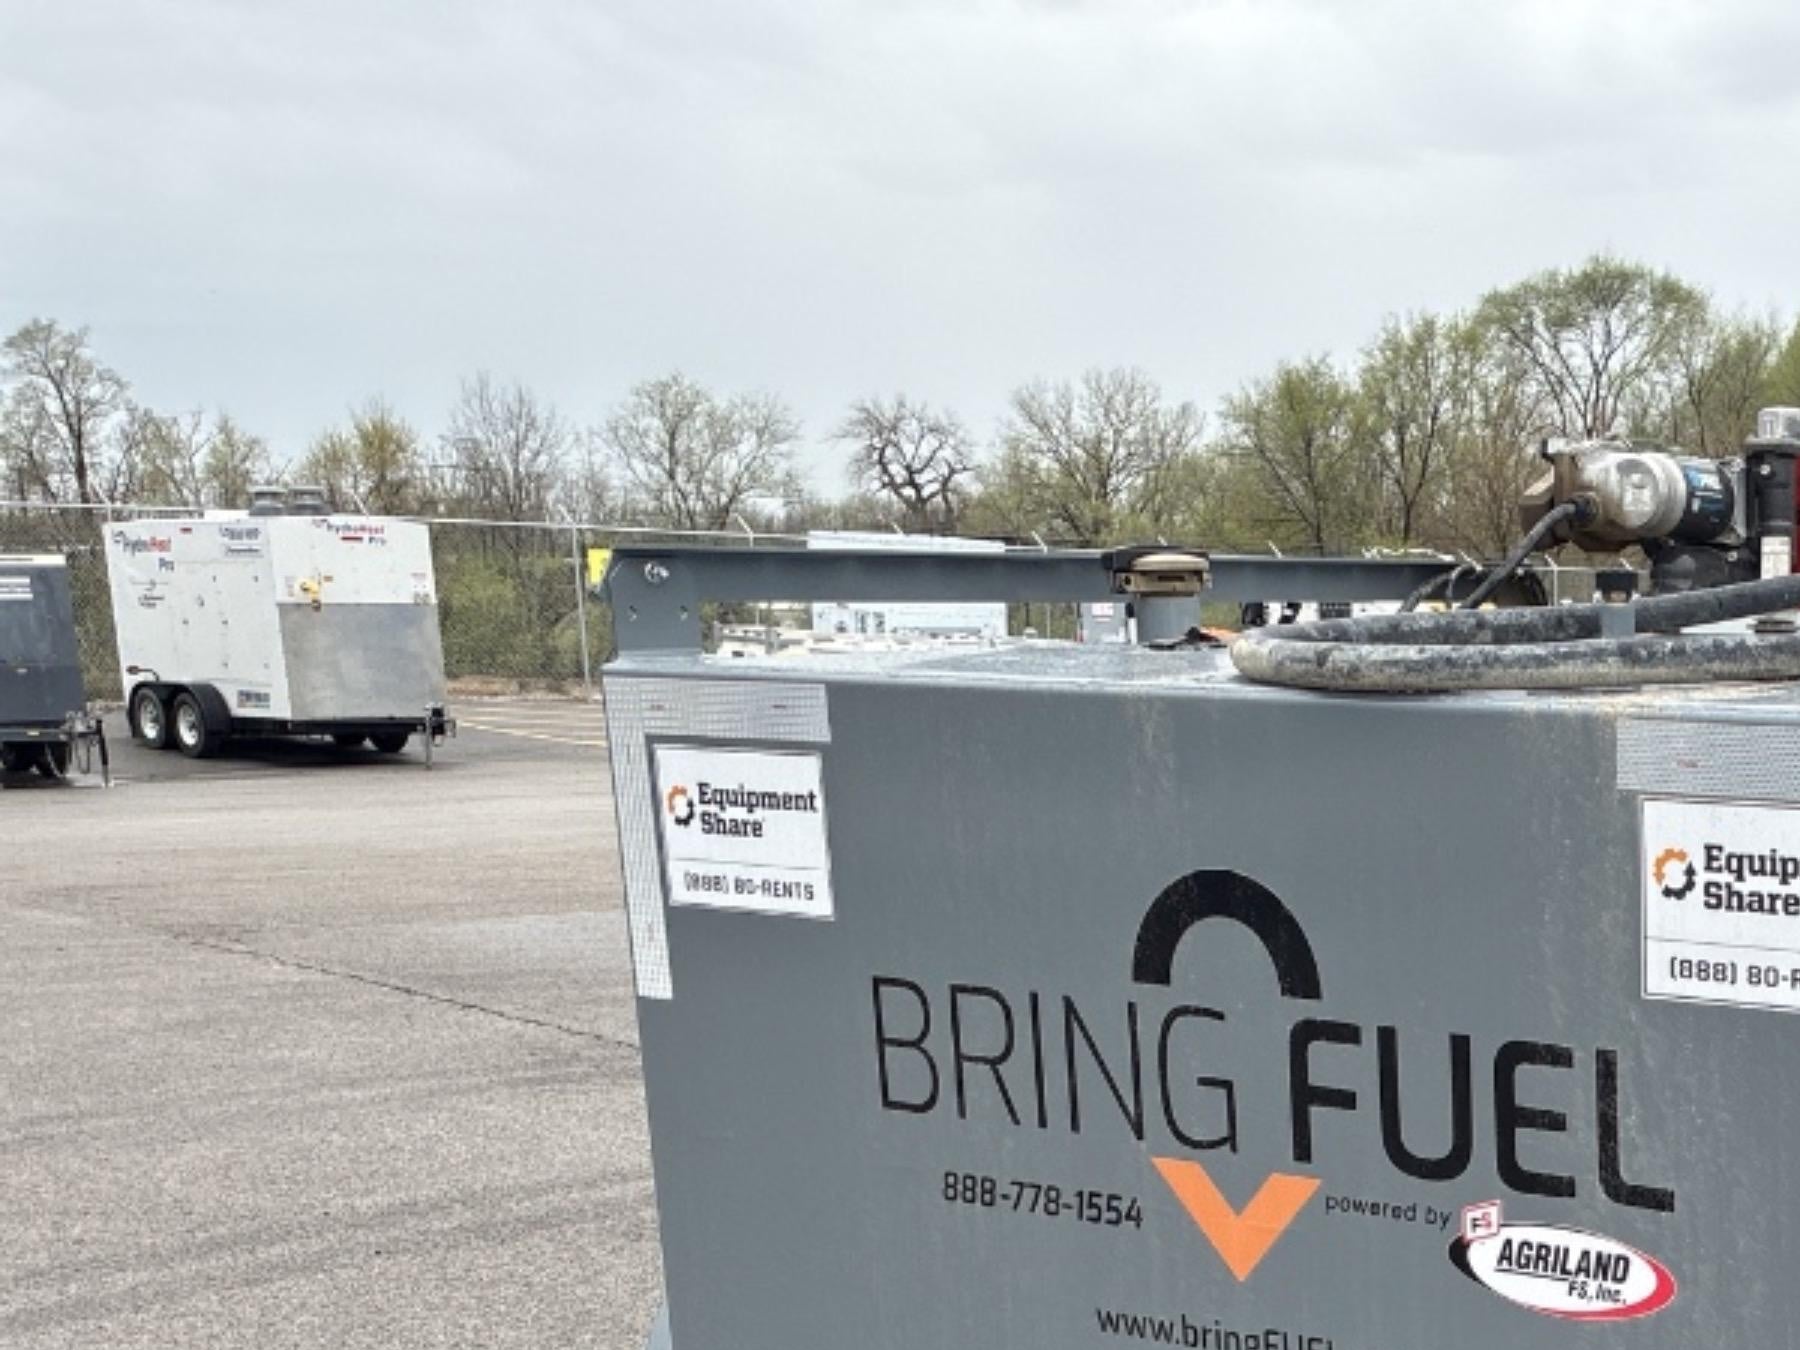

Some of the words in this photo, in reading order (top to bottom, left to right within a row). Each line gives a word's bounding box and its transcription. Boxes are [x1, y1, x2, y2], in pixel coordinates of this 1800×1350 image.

[697, 782, 818, 813] Equipment
[701, 811, 764, 838] Share
[684, 870, 729, 893] (888)
[734, 876, 815, 900] 80-RENTS
[1703, 881, 1800, 916] Share
[1669, 956, 1738, 985] (888)
[872, 975, 1238, 1154] BRING
[1289, 1017, 1675, 1213] FUEL
[943, 1171, 1144, 1229] 888-778-1554
[1324, 1195, 1417, 1223] powered
[1425, 1202, 1452, 1231] by
[1497, 1238, 1630, 1284] AGRILAND
[1595, 1283, 1628, 1304] Inc.
